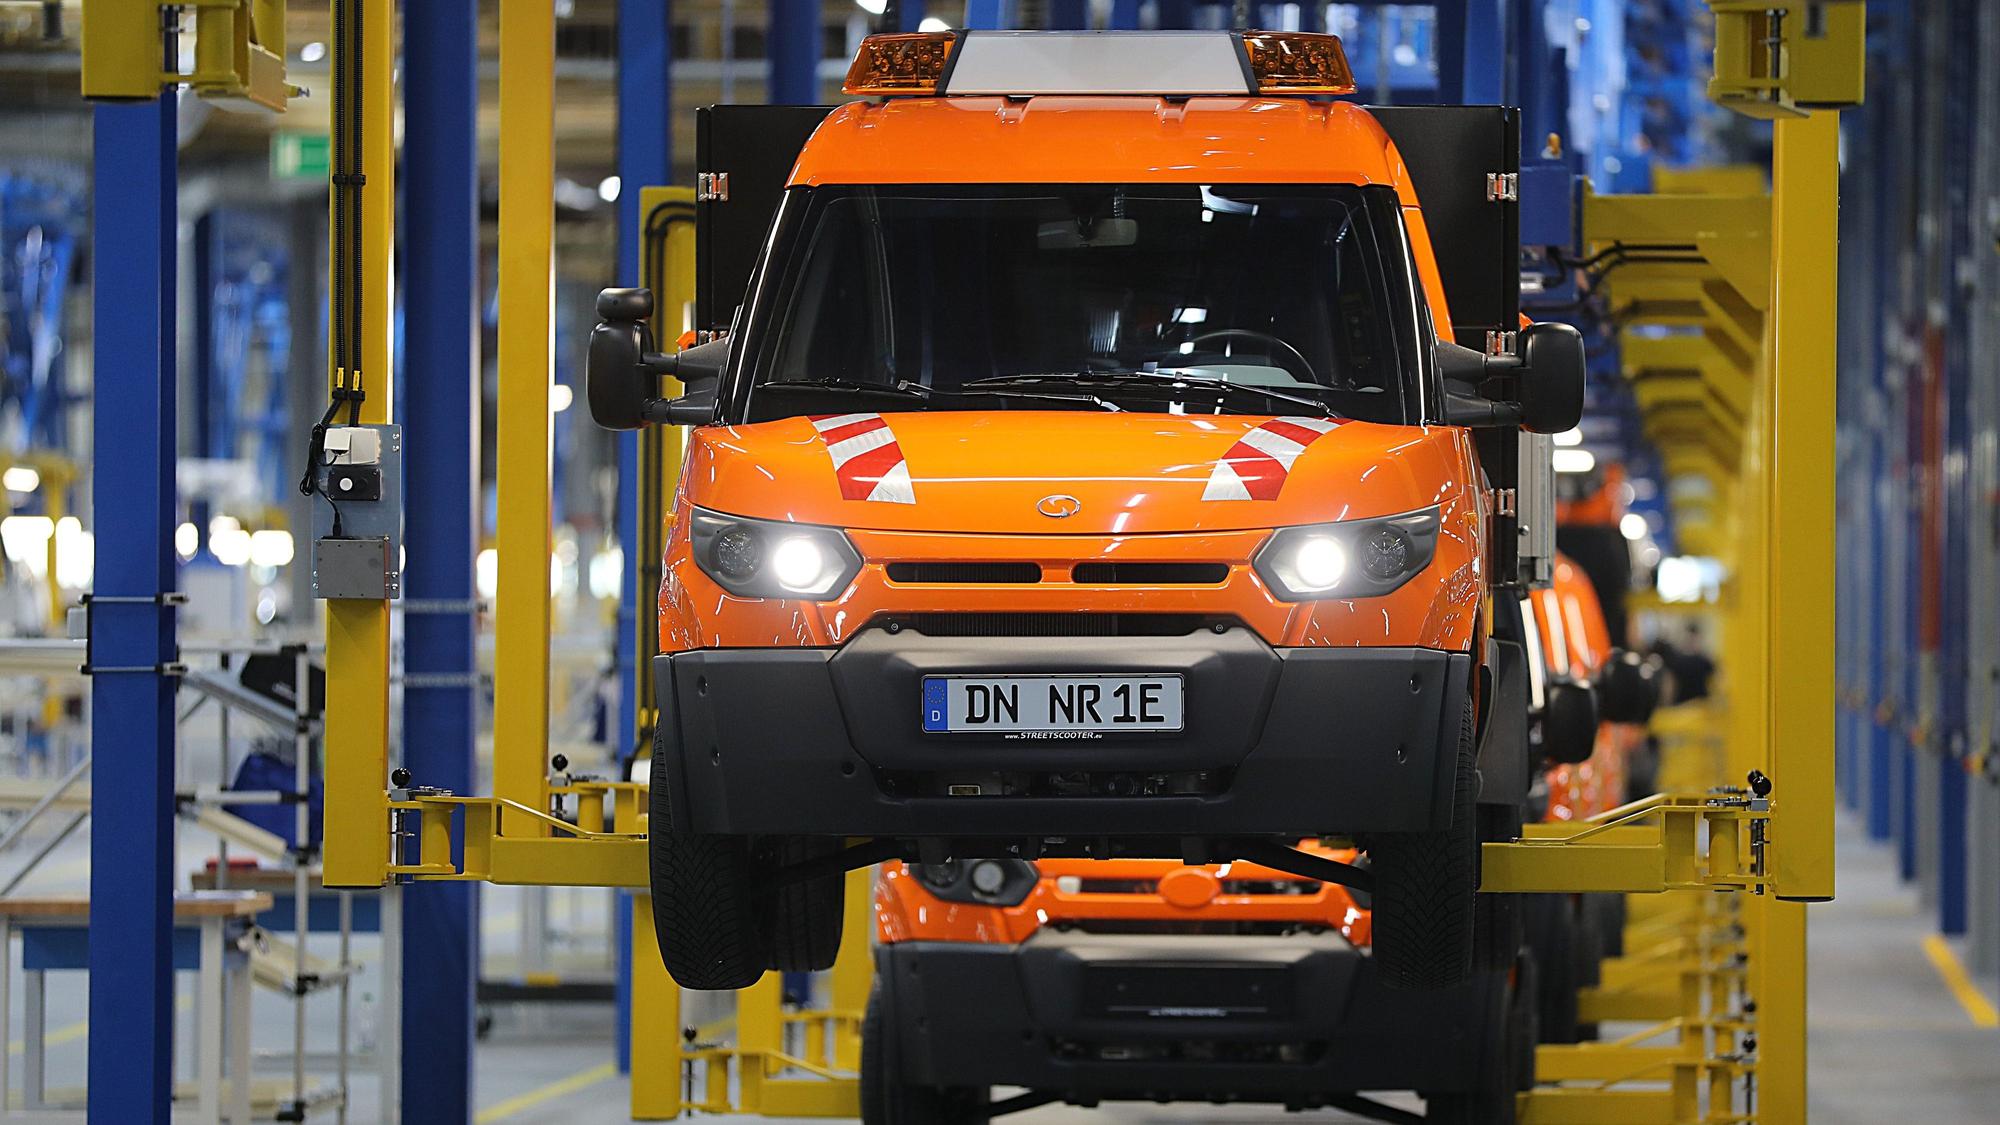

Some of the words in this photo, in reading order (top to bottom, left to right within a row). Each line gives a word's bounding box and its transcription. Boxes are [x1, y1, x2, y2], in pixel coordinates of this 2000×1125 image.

[965, 684, 1018, 723] DN
[1049, 684, 1102, 723] NR
[1112, 683, 1164, 723] 1E
[931, 710, 940, 721] D
[1004, 731, 1102, 739] www.STREETSCOOTER.eu
